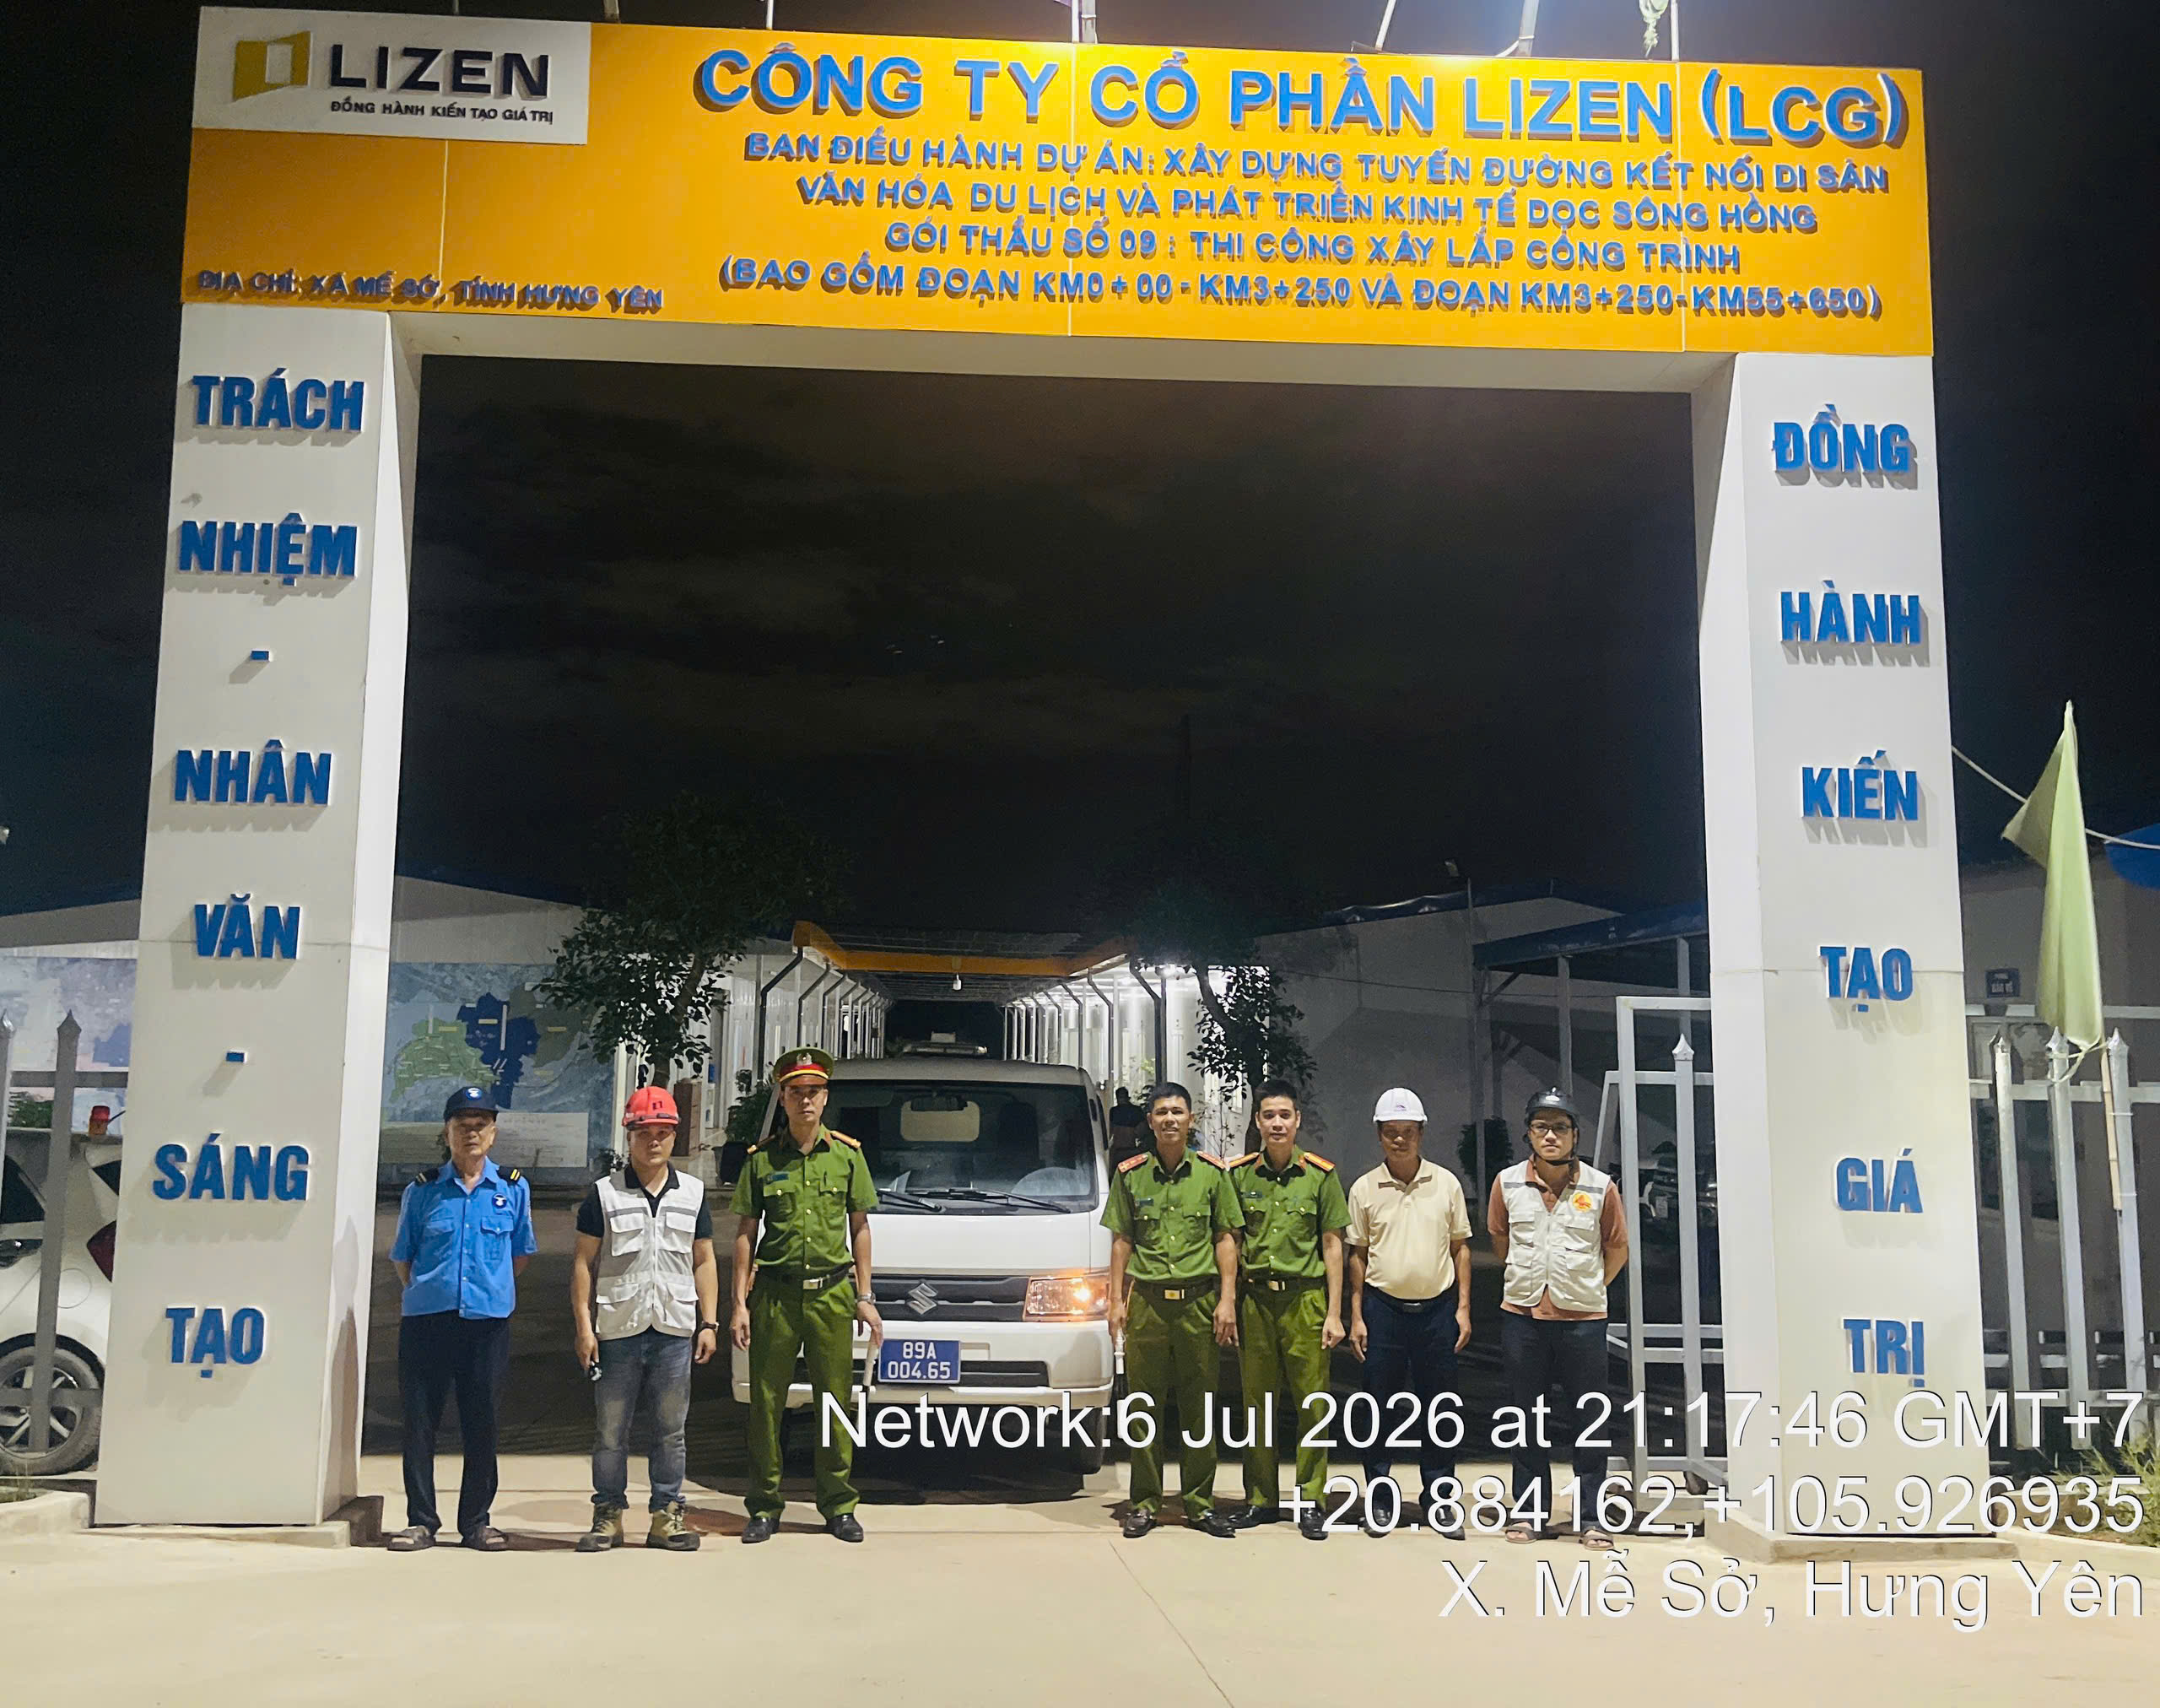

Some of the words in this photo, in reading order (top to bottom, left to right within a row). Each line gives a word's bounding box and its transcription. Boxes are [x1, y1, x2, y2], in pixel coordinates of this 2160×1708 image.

[330, 44, 548, 98] LIZEN
[699, 42, 923, 119] CÔNG
[955, 60, 1059, 123] TY
[1090, 51, 1199, 129] CỔ
[1230, 57, 1435, 137] PHẦN
[1464, 78, 1672, 143] LIZEN
[1701, 68, 1909, 149] (LCG)
[382, 101, 424, 116] HÀNH
[431, 102, 466, 117] KIẾN
[471, 107, 498, 122] TẠO
[502, 106, 526, 121] GIÁ
[529, 111, 554, 125] TRỊ
[746, 132, 820, 161] BAN
[923, 133, 1023, 170] HÀNH
[1037, 143, 1088, 181] DỰ
[1094, 139, 1154, 175] ÁN:
[1164, 143, 1232, 176] XÂY
[1242, 149, 1343, 183] DỰNG
[1357, 148, 1470, 184] TUYẾN
[1482, 154, 1612, 189] ĐƯỜNG
[1626, 151, 1693, 190] KẾT
[1705, 154, 1763, 192] NỐI
[1775, 164, 1807, 192] DI
[878, 174, 953, 210] HÓA
[971, 182, 1016, 213] DU
[1029, 185, 1105, 221] LỊCH
[1117, 182, 1160, 218] VÀ
[1173, 185, 1262, 219] PHÁT
[1273, 181, 1373, 222] TRIỂN
[1384, 195, 1462, 224] KINH
[1474, 187, 1515, 227] TẾ
[1529, 199, 1600, 234] DỌC
[1612, 196, 1709, 230] SÔNG
[1719, 192, 1817, 233] HỒNG
[886, 216, 948, 252] GÓI
[1063, 215, 1110, 258] SỐ
[1120, 230, 1156, 258] 09
[1190, 231, 1244, 261] THI
[1255, 227, 1354, 264] CÔNG
[1367, 230, 1434, 266] XÂY
[1526, 226, 1625, 271] CÔNG
[1638, 238, 1741, 273] TRÌNH
[523, 283, 600, 307] HƯNG
[608, 285, 664, 310] YÊN
[720, 255, 811, 291] (BAO
[917, 267, 1019, 307] ĐOẠN
[1361, 273, 1401, 309] VÀ
[1414, 279, 1509, 316] ĐOẠN
[192, 367, 365, 432] TRÁCH
[1771, 403, 1912, 474] ĐỒNG
[178, 512, 359, 586] NHIỆM
[1779, 579, 1922, 646] HÀNH
[174, 738, 332, 805] NHÂN
[1801, 749, 1920, 820] KIẾN
[193, 893, 301, 960] VĂN
[1818, 945, 1914, 1013] TẠO
[151, 1132, 310, 1202] SÁNG
[1834, 1147, 1924, 1213] GIÁ
[165, 1306, 266, 1379] TẠO
[888, 1360, 951, 1379] 004.65
[902, 1341, 937, 1359] 89A
[1842, 1318, 1925, 1388] TRỊ
